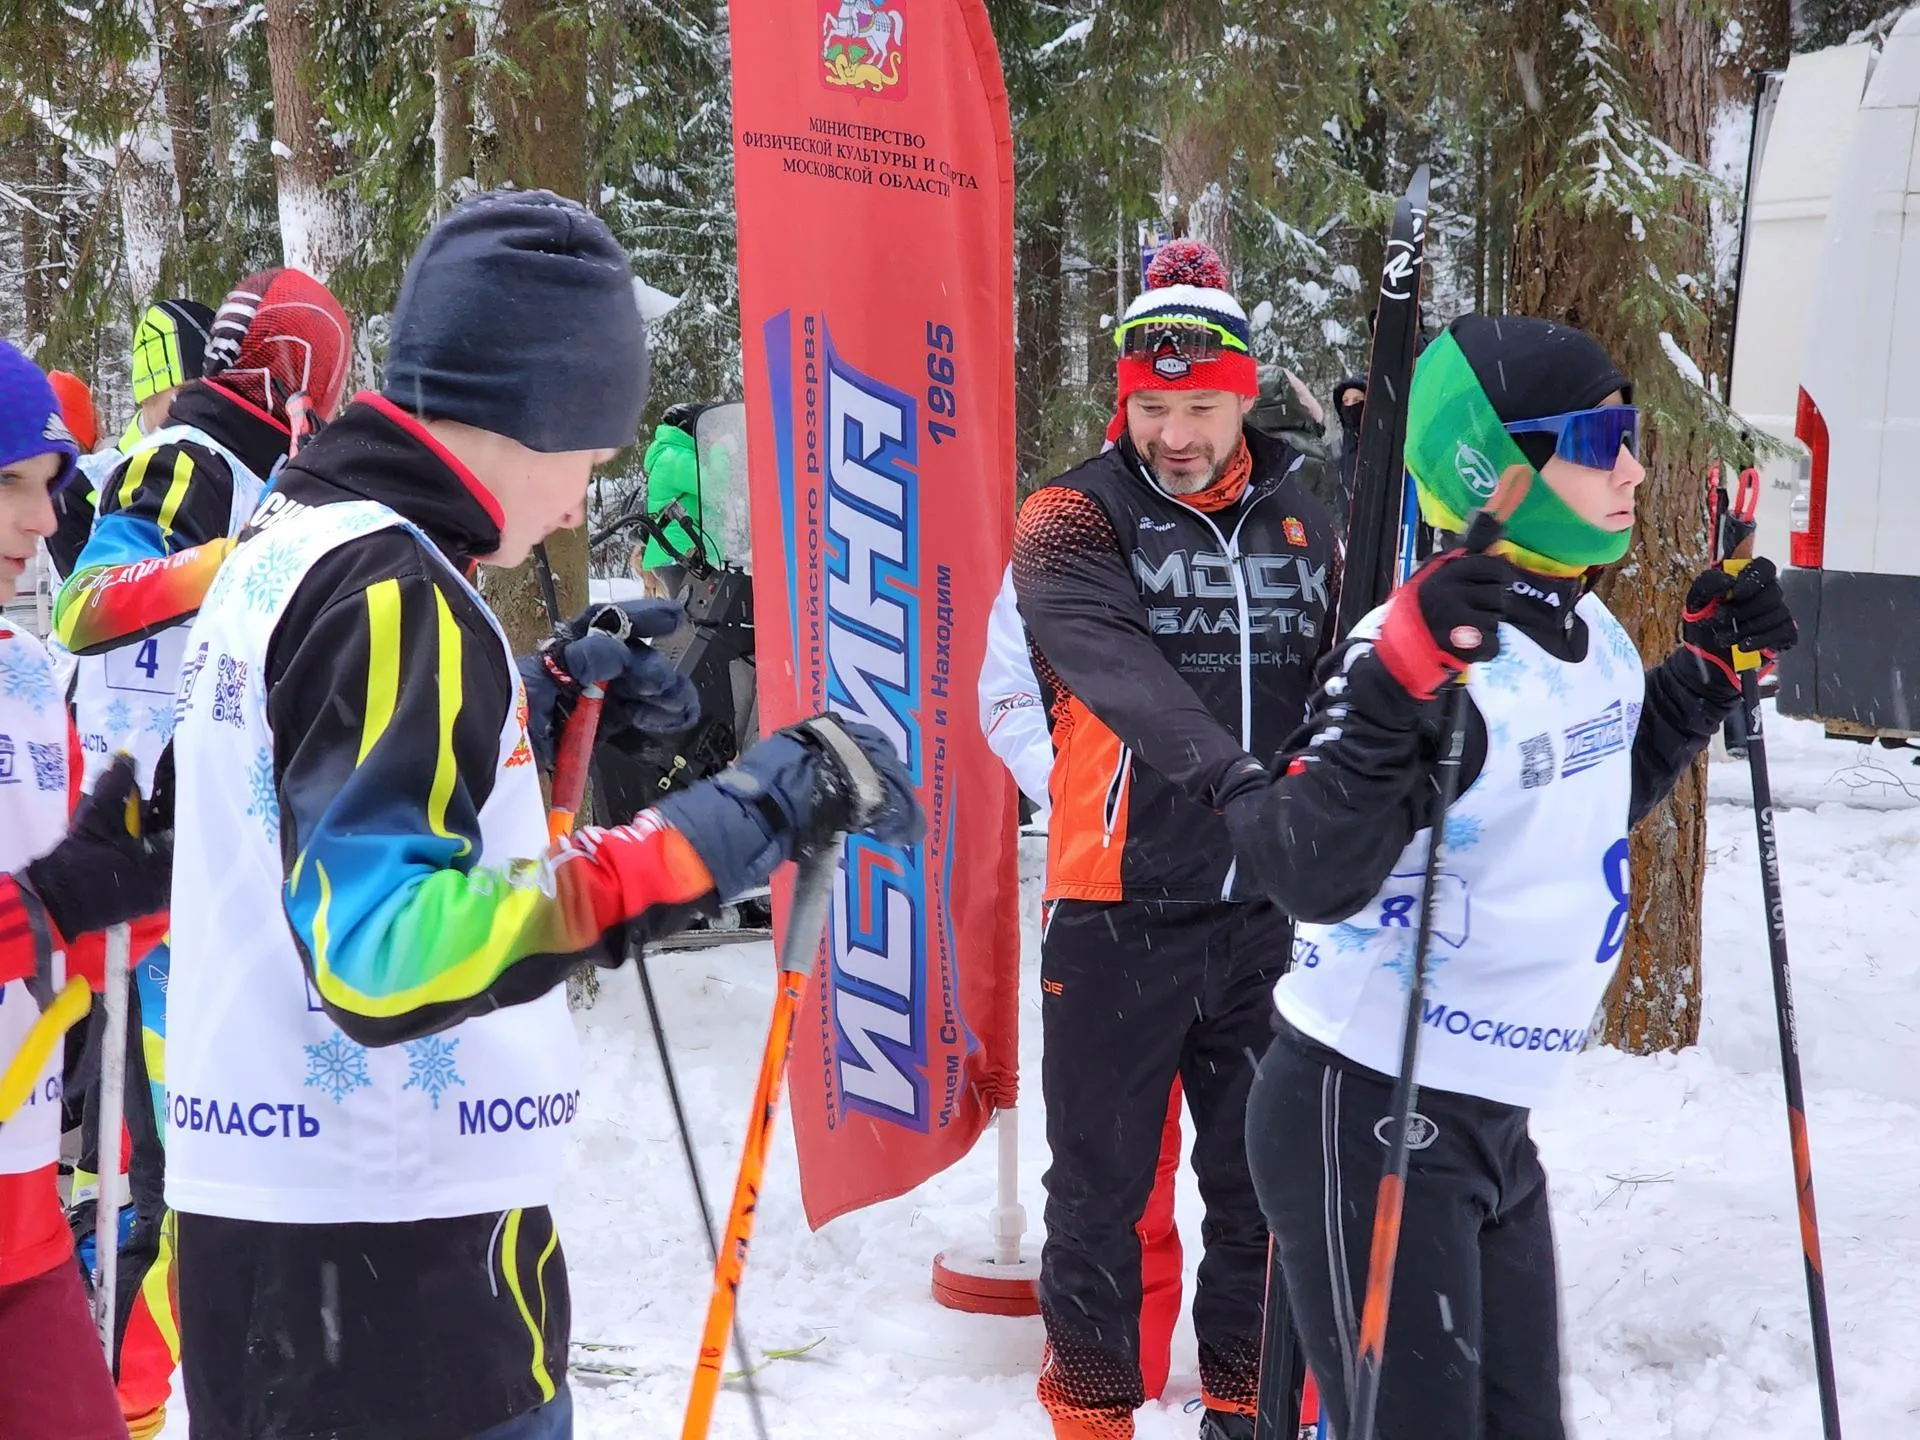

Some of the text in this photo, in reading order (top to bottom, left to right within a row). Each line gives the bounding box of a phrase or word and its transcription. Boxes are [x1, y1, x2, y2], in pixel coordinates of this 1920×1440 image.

[808, 116, 926, 149] МИНИСТЕРСТВО
[742, 131, 979, 190] ФИЗИЧЕСКОЙ КУЛЬТУРЫ И СРТА
[783, 158, 951, 198] МОСКОВСКОЙ ОБЛАСТИ
[926, 320, 957, 446] 1965
[930, 565, 955, 698] Находим
[1146, 606, 1317, 639] БЛАСТЬ
[135, 639, 159, 679] 4
[804, 316, 835, 1130] спортивна импийского резерва
[828, 350, 918, 1122] ИСИНА
[935, 709, 947, 726] и
[81, 735, 108, 753] АСТЬ
[930, 737, 947, 860] Таланты
[174, 1094, 320, 1138] ОБЛАСТЬ
[939, 1054, 959, 1128] Ищем
